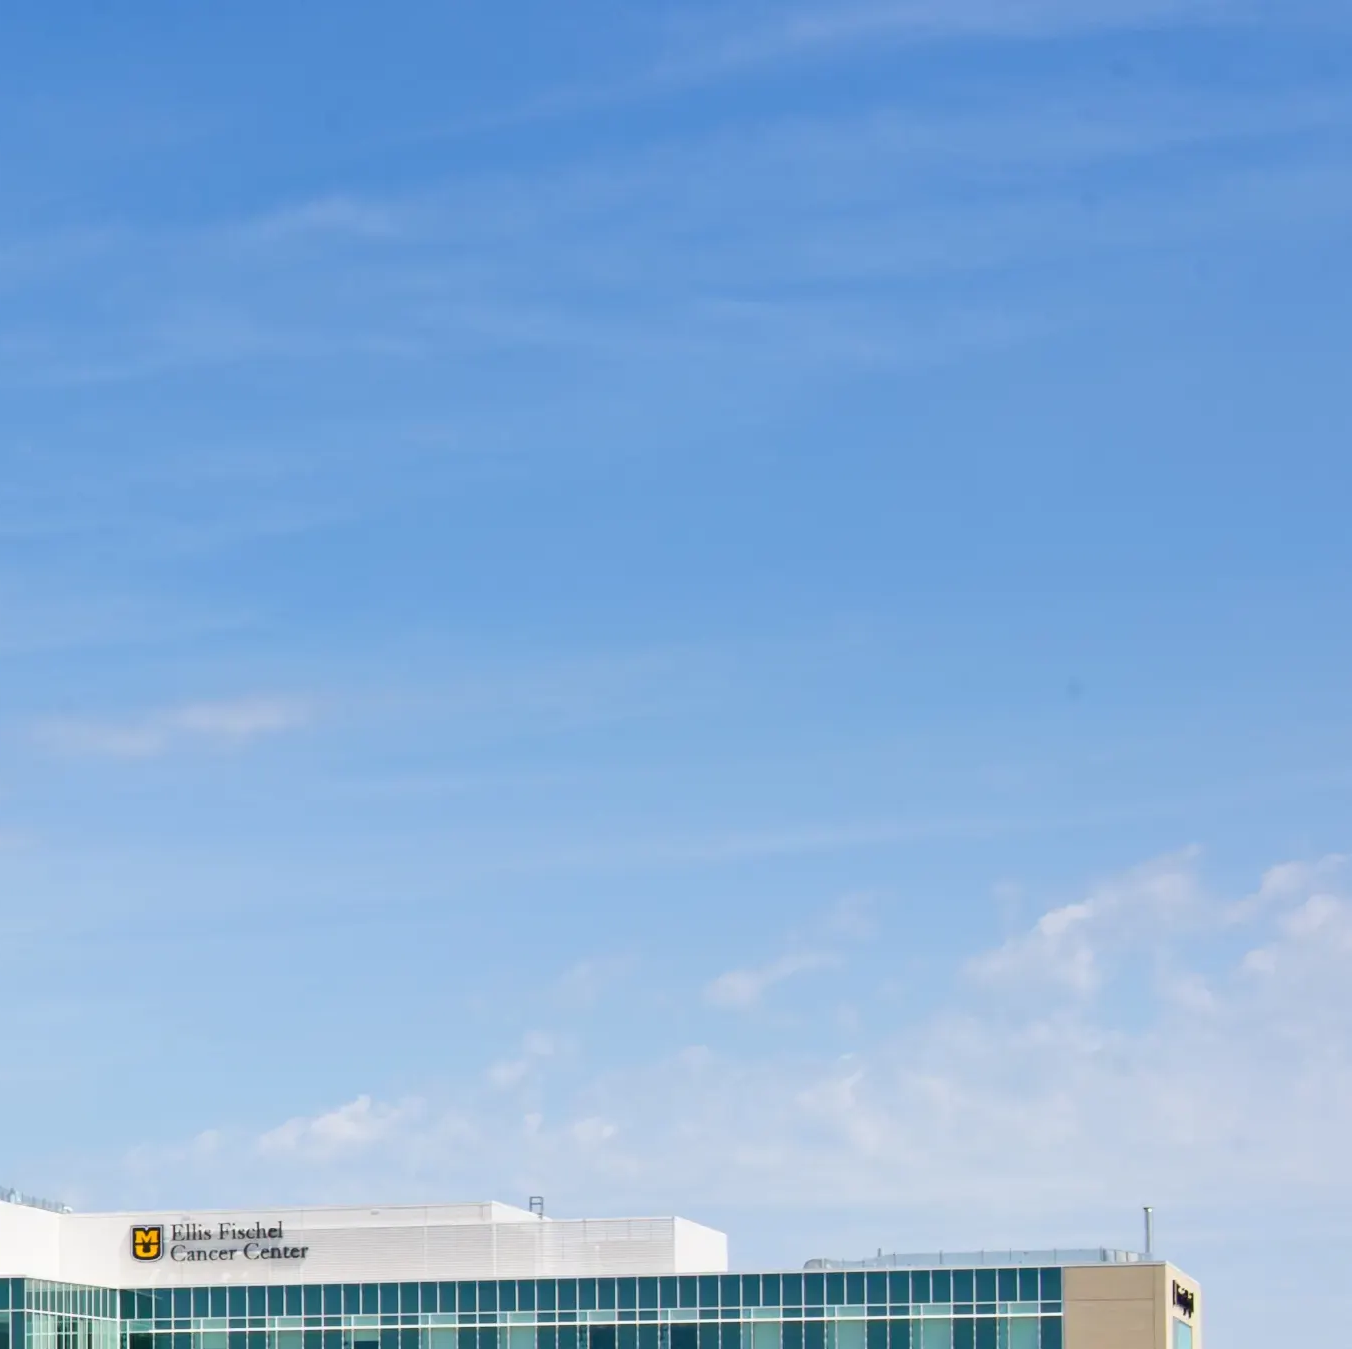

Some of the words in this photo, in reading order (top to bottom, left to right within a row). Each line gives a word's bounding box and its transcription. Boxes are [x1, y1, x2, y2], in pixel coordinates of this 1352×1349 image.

[170, 1223, 212, 1242] Ellis
[218, 1221, 284, 1240] Fischel
[170, 1244, 238, 1262] Cancer
[243, 1243, 309, 1261] Center
